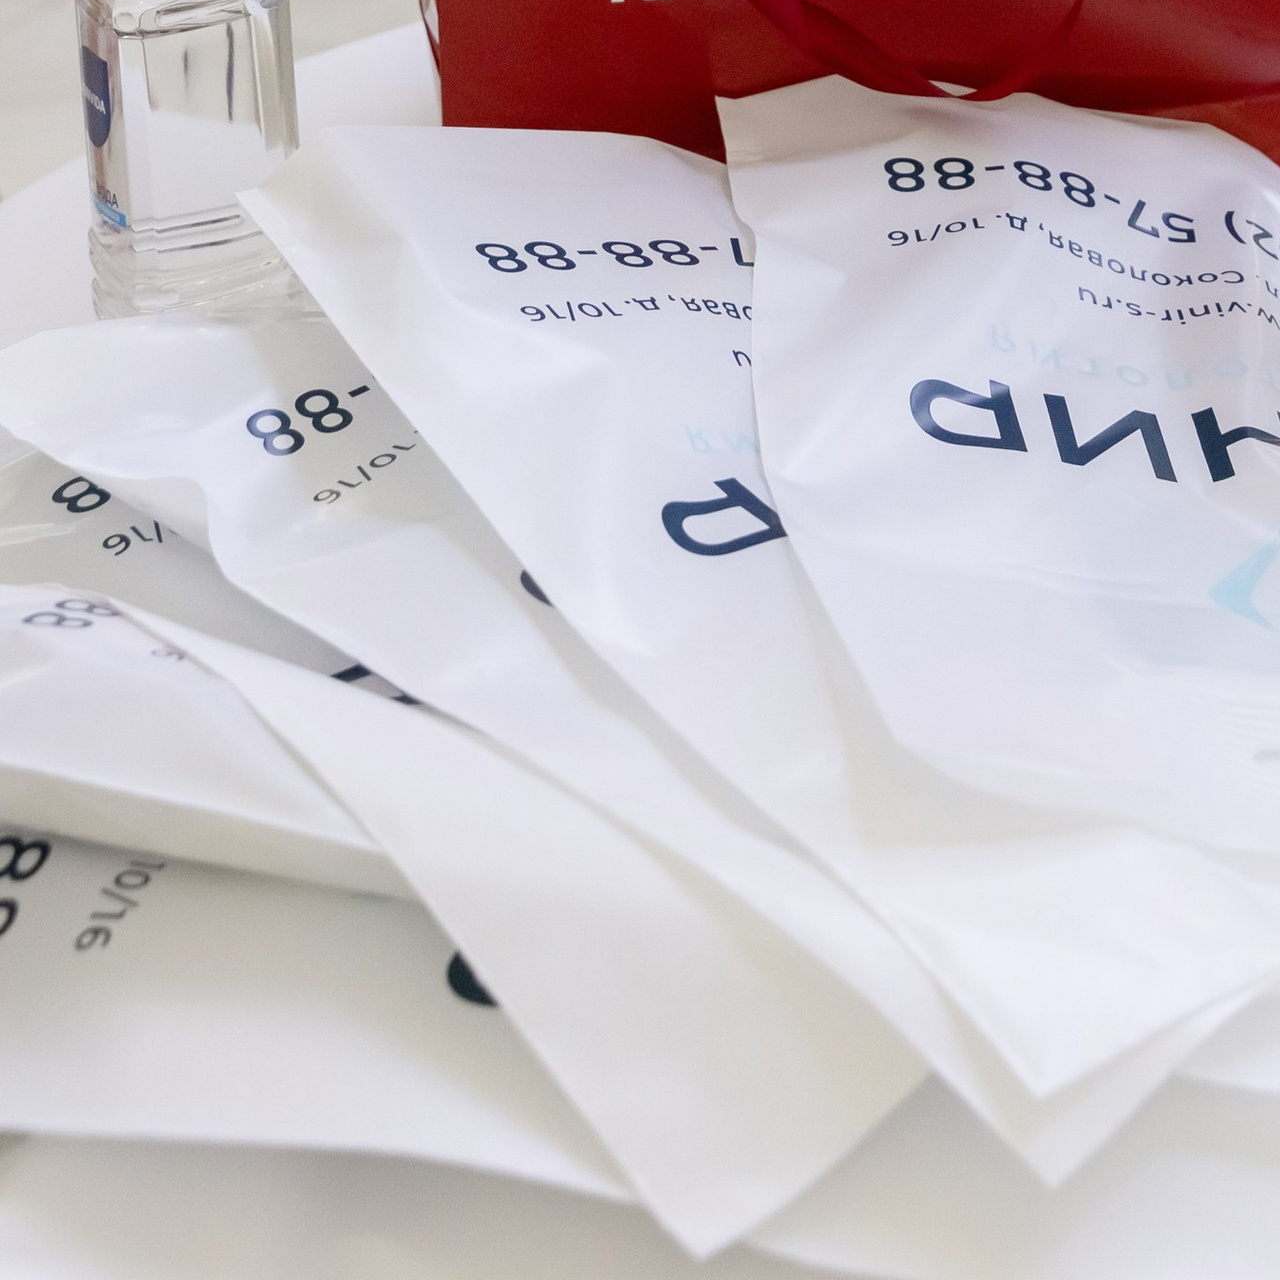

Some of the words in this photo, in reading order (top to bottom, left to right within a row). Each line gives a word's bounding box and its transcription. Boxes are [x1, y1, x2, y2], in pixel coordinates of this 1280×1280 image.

[883, 156, 1196, 244] 57-88-88
[887, 217, 985, 247] 10/16
[1038, 222, 1245, 287] Соколовая,
[520, 300, 623, 322] 10/16
